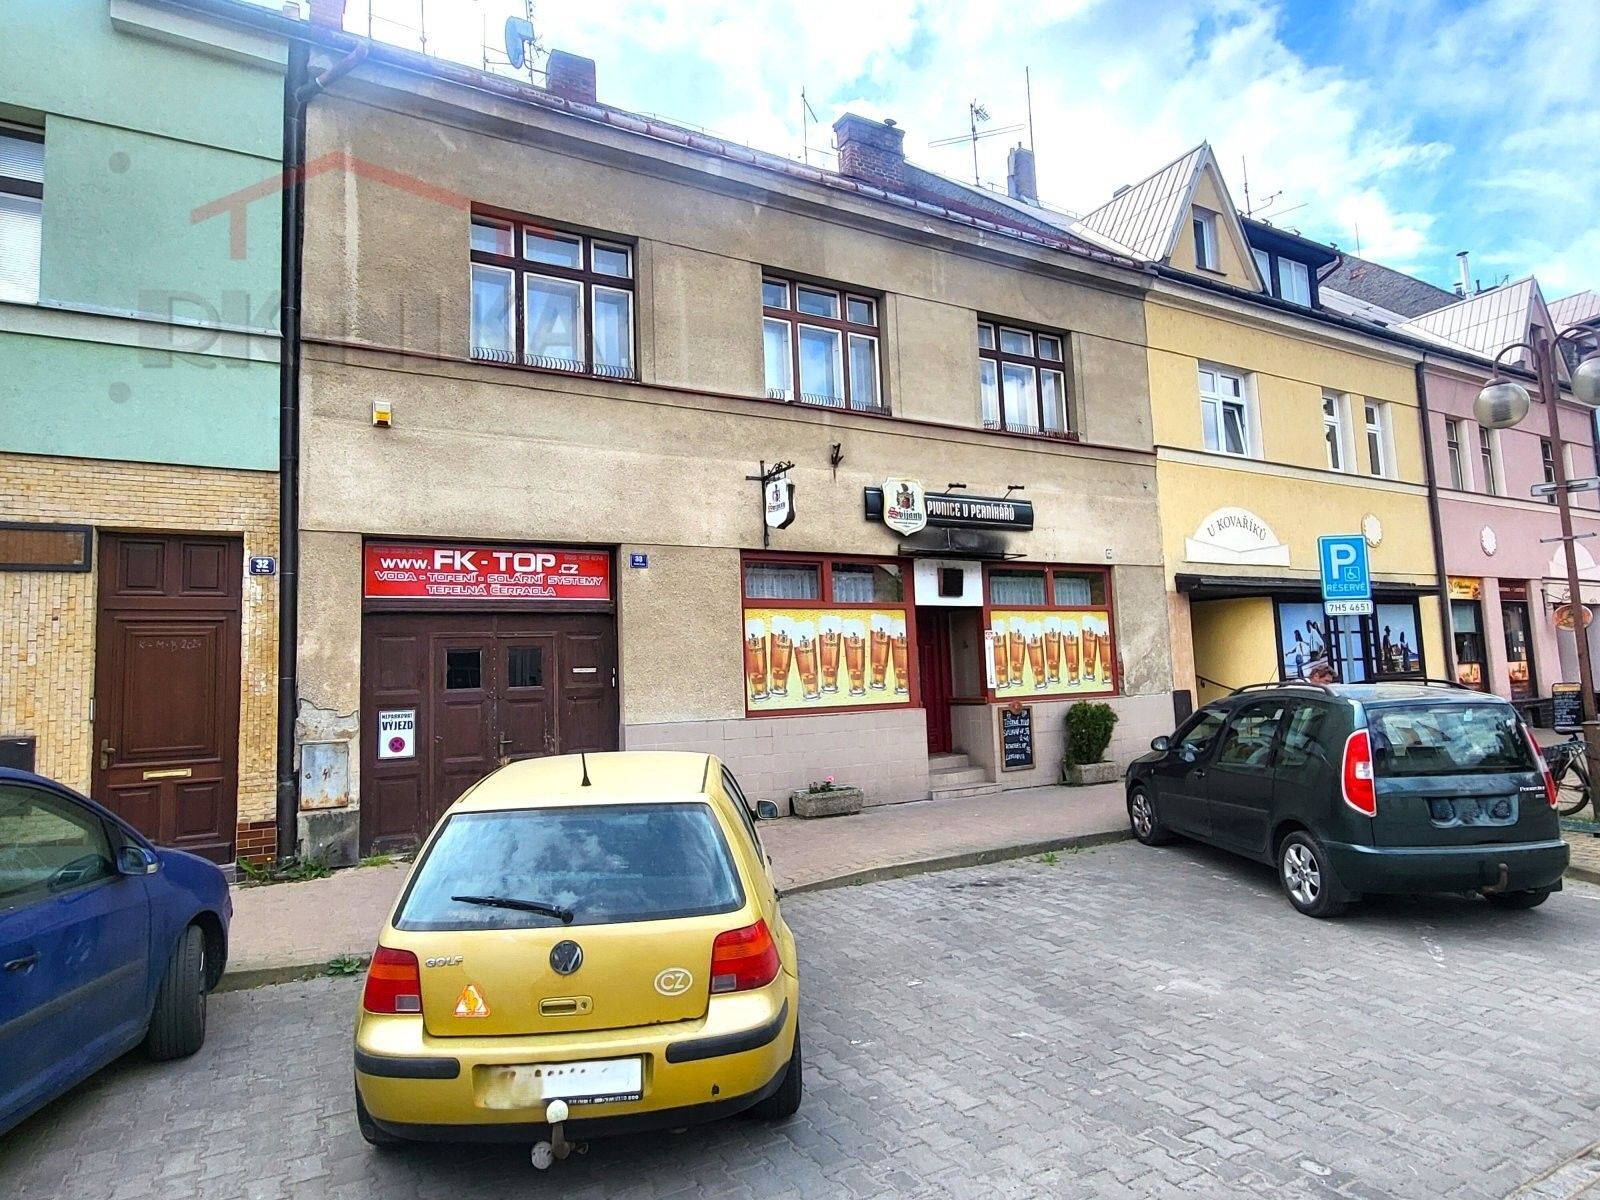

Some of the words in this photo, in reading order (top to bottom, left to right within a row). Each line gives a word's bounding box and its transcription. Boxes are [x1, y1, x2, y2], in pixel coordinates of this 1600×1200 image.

[888, 506, 922, 520] Svijany
[927, 501, 961, 516] PIVNICE
[963, 504, 968, 517] U
[970, 503, 1015, 521] PERNÍKÁŘŮ
[1207, 524, 1216, 537] U
[1216, 514, 1267, 541] KOVAŘÍKŮ
[256, 560, 269, 569] 32
[1329, 543, 1357, 579] P
[375, 570, 417, 582] VODA
[427, 571, 479, 583] TOPENÍ
[487, 573, 545, 585] SOLÁRNÍ
[547, 576, 604, 586] SYSTEMY
[426, 583, 487, 595] TEPELNÁ
[490, 584, 556, 597] ČERPADLA
[1350, 603, 1370, 612] 4651
[381, 720, 413, 731] VÝJEZD
[425, 955, 464, 968] GOLF
[660, 973, 687, 990] CZ
